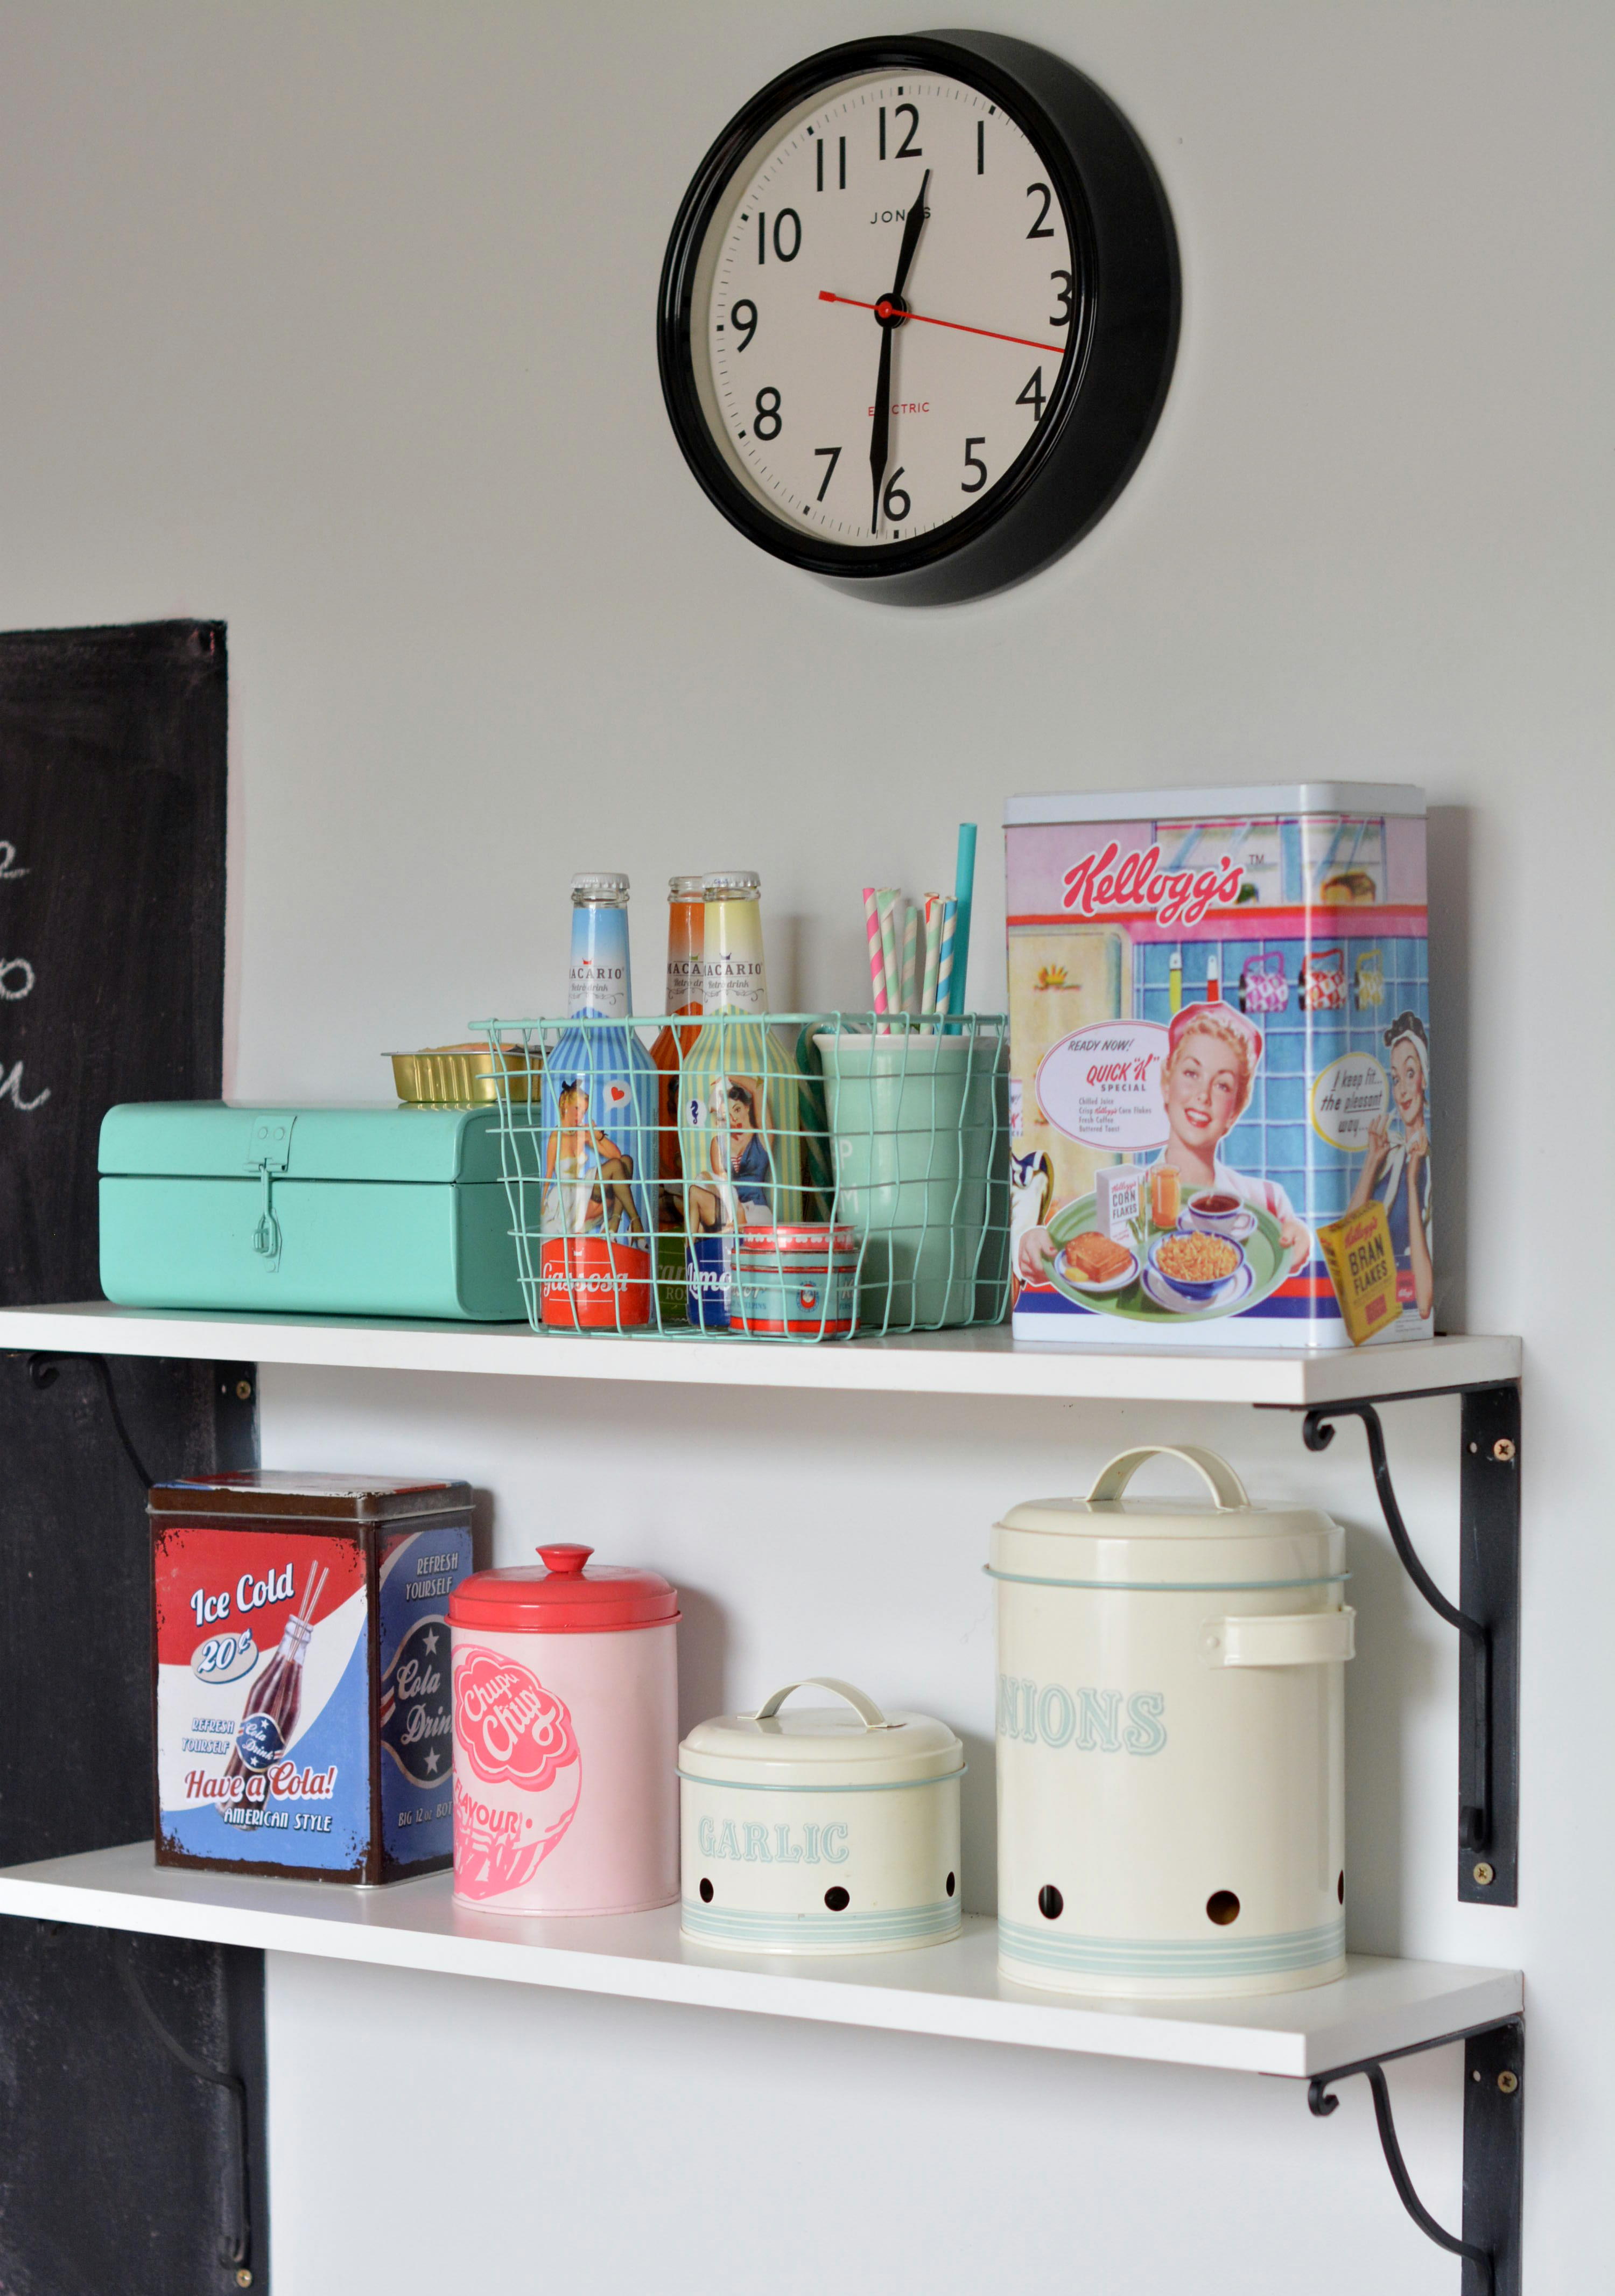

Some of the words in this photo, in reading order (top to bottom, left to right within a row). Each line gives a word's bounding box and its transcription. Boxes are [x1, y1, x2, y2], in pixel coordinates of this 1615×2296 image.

[879, 103, 923, 160] 12
[977, 121, 985, 175] 1
[816, 136, 846, 192] 11
[870, 206, 931, 225] JONS
[1026, 183, 1055, 239] 2
[757, 208, 802, 264] 10
[1049, 270, 1072, 326] 3
[731, 299, 759, 353] 9
[1015, 366, 1047, 422] 4
[754, 387, 783, 441] 8
[868, 402, 930, 417] ECTRIC
[814, 447, 842, 502] 7
[961, 437, 987, 493] 5
[883, 467, 911, 521] 6
[1063, 842, 1244, 925] Kellogg's
[569, 968, 622, 979] ACARIO
[704, 964, 761, 976] ACARIO
[1068, 1040, 1100, 1051] READY
[1102, 1038, 1135, 1052] NOW!
[1086, 1062, 1132, 1086] QUICK
[1341, 1070, 1363, 1089] keep
[1101, 1083, 1146, 1092] SPECIAL
[1134, 1106, 1151, 1114] Flakes
[1321, 1094, 1342, 1111] the
[1344, 1090, 1382, 1113] pleasant
[1113, 1191, 1135, 1207] CORN
[1113, 1203, 1137, 1219] FLAKES
[1348, 1234, 1384, 1276] BRAN
[1353, 1260, 1388, 1296] FLAKES
[417, 1552, 458, 1576] REFRESH
[190, 1588, 230, 1627] Ice
[236, 1563, 295, 1613] Cold
[405, 1576, 453, 1601] YOURSELF
[397, 1659, 441, 1700] Cola
[192, 1718, 235, 1735] REFRESH
[245, 1723, 266, 1741] Cola
[181, 1738, 229, 1755] YOURSELF
[242, 1738, 273, 1760] Drink
[184, 1770, 243, 1802] Have
[245, 1775, 266, 1802] a
[268, 1760, 338, 1801] Cola!
[223, 1808, 288, 1828] AMERICAN
[294, 1812, 333, 1832] STYLE
[398, 1811, 412, 1828] BIG
[416, 1808, 423, 1823] 12
[698, 1815, 849, 1864] GARLIC
